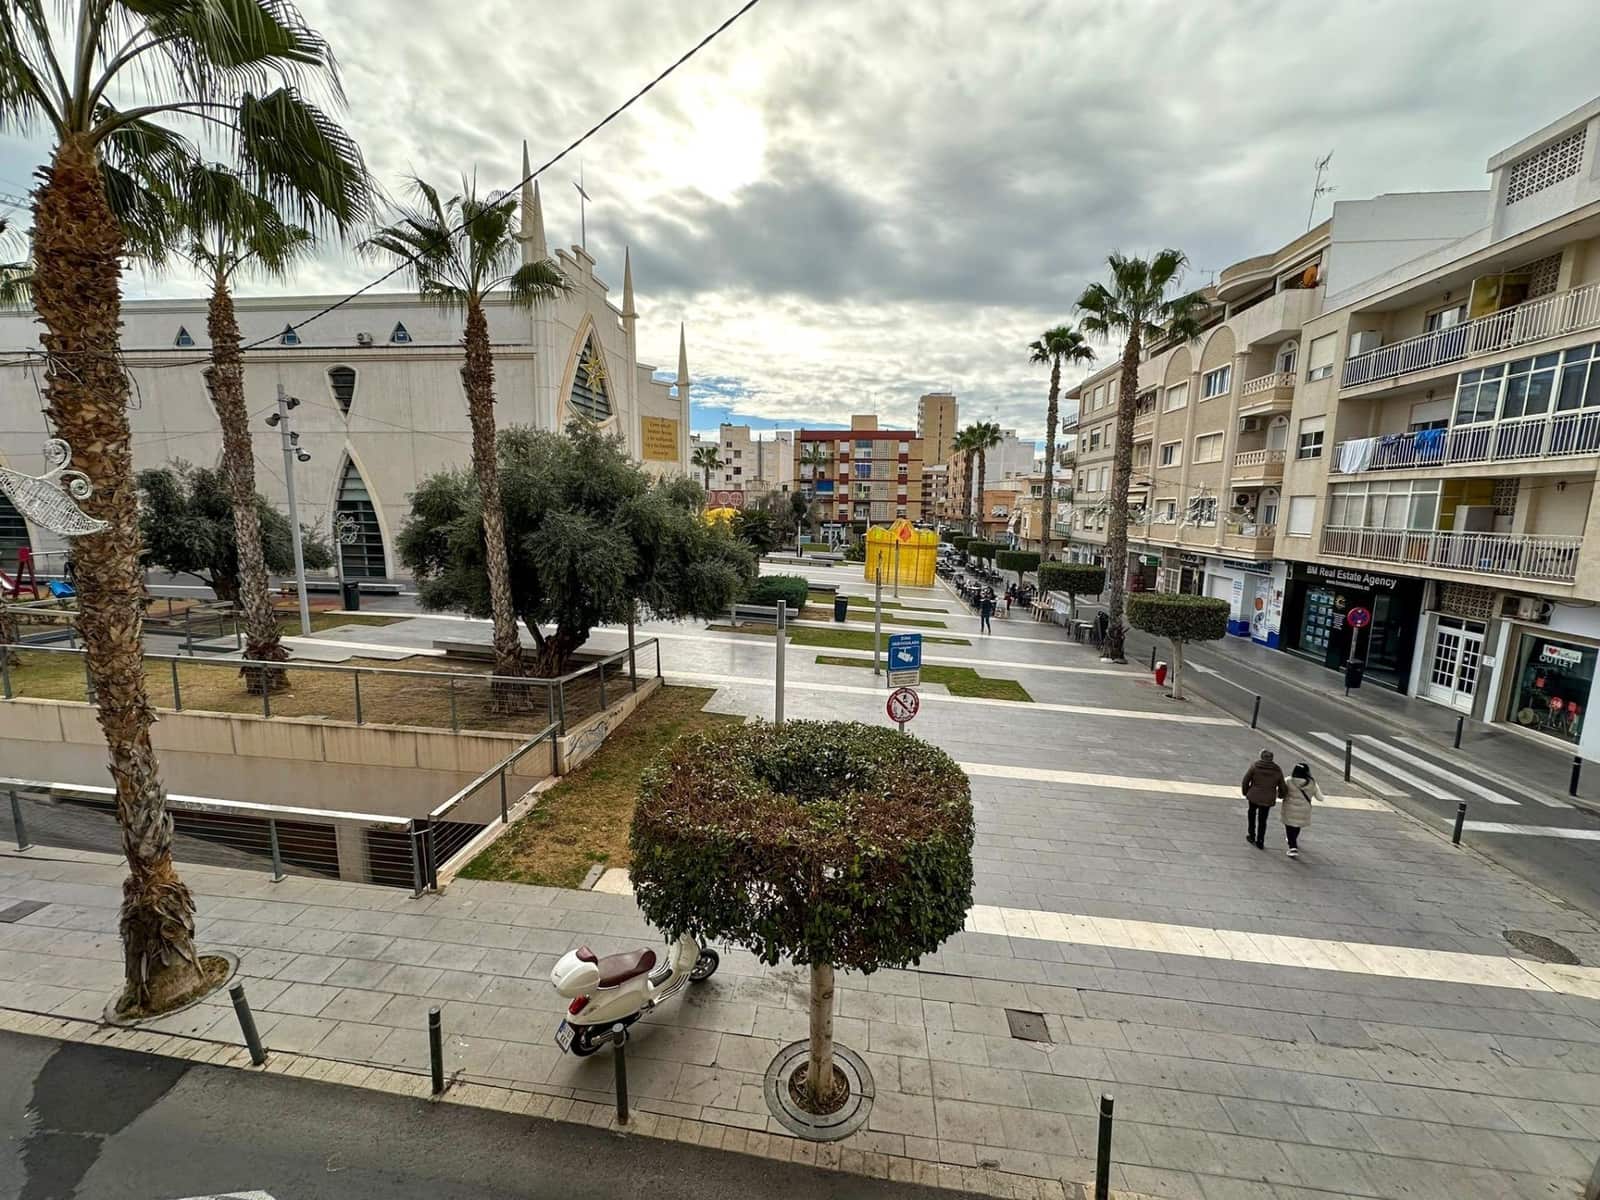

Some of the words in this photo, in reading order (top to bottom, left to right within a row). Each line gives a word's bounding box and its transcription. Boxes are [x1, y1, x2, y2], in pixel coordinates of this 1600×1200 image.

[1319, 567, 1336, 578] Real
[1337, 569, 1362, 582] Estate
[1362, 573, 1397, 590] Agency
